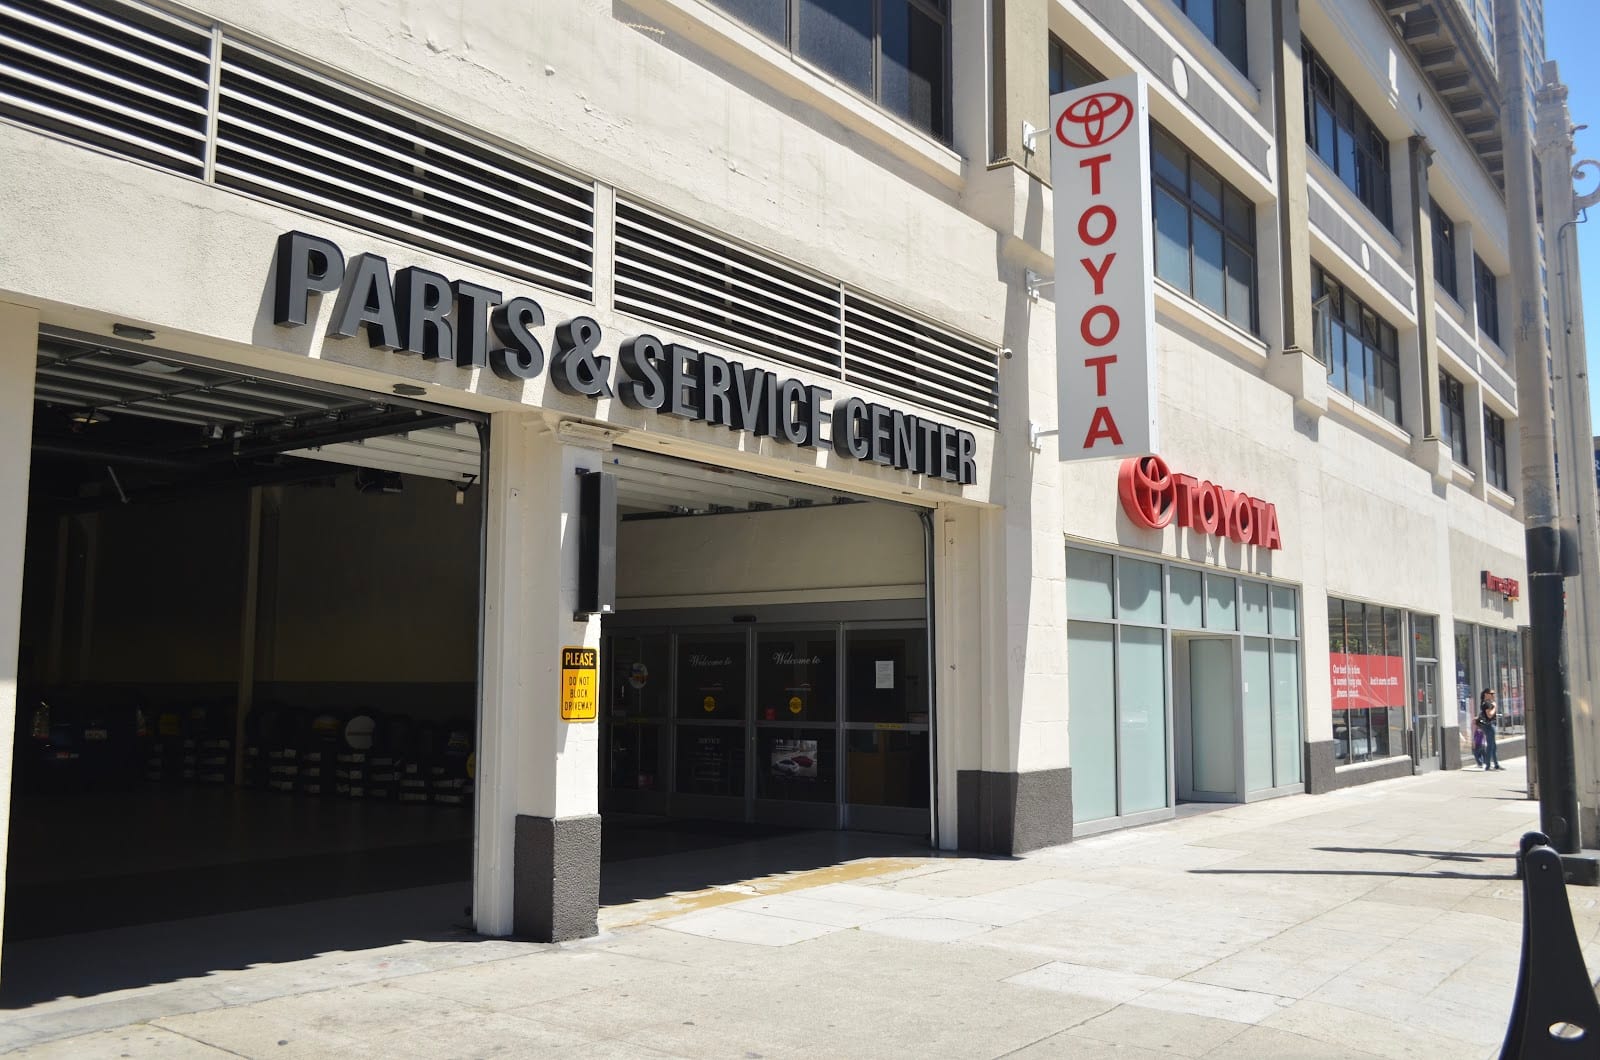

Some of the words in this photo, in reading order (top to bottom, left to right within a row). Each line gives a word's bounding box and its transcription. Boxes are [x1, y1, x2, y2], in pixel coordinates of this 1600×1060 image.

[1077, 153, 1124, 449] TOYOTA
[273, 230, 545, 380] PARTS
[550, 315, 614, 398] &
[618, 334, 832, 450] SERVICE
[833, 397, 978, 485] CENTER
[1174, 473, 1282, 550] TOYOTA
[565, 652, 594, 666] PLEASE
[688, 654, 724, 666] Welcome
[724, 657, 733, 666] to
[772, 652, 810, 665] Welcome
[810, 655, 821, 665] to
[568, 676, 577, 686] DO
[579, 676, 590, 686] NOT
[569, 688, 588, 698] BLOCK
[564, 701, 593, 711] DRIVEWAY
